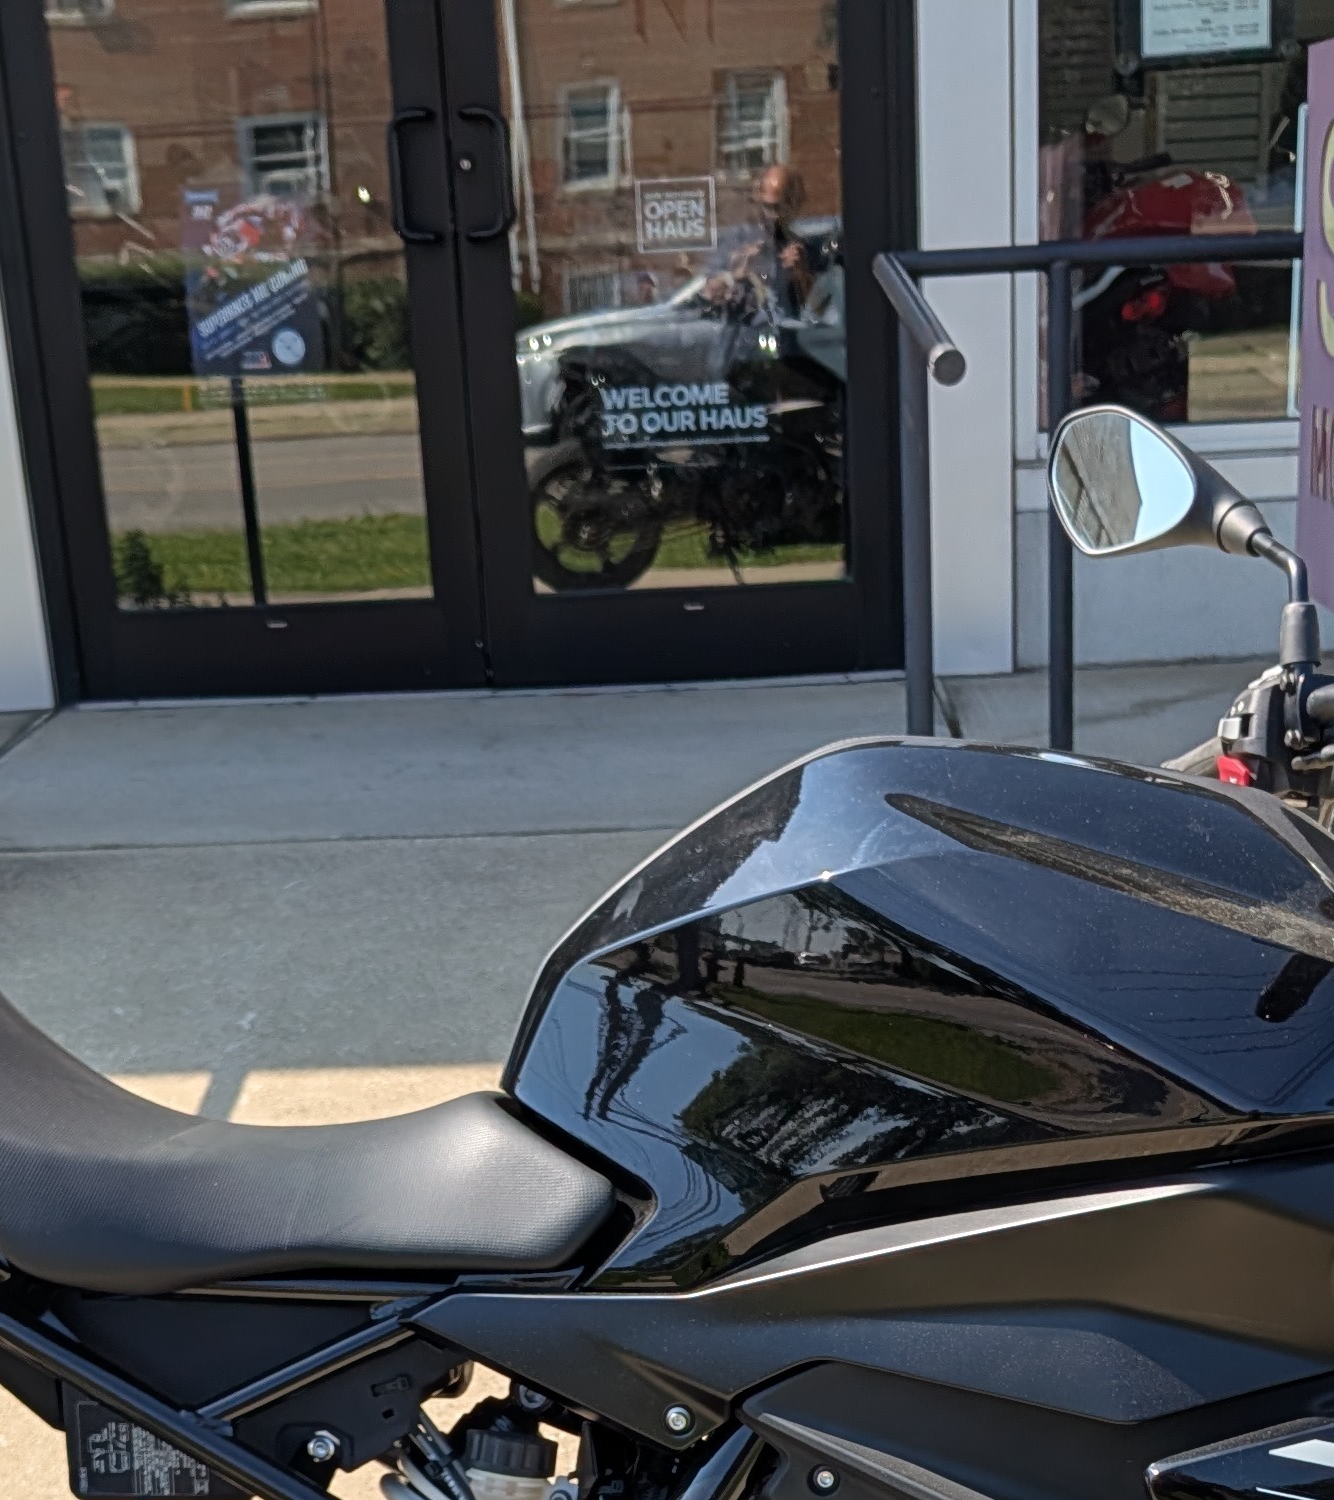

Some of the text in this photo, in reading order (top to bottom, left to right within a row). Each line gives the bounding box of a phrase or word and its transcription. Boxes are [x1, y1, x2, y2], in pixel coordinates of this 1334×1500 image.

[644, 200, 706, 220] OPEN
[644, 219, 706, 240] HAUS
[601, 382, 730, 410] WELCOME
[602, 404, 768, 435] TO OUR HAUS
